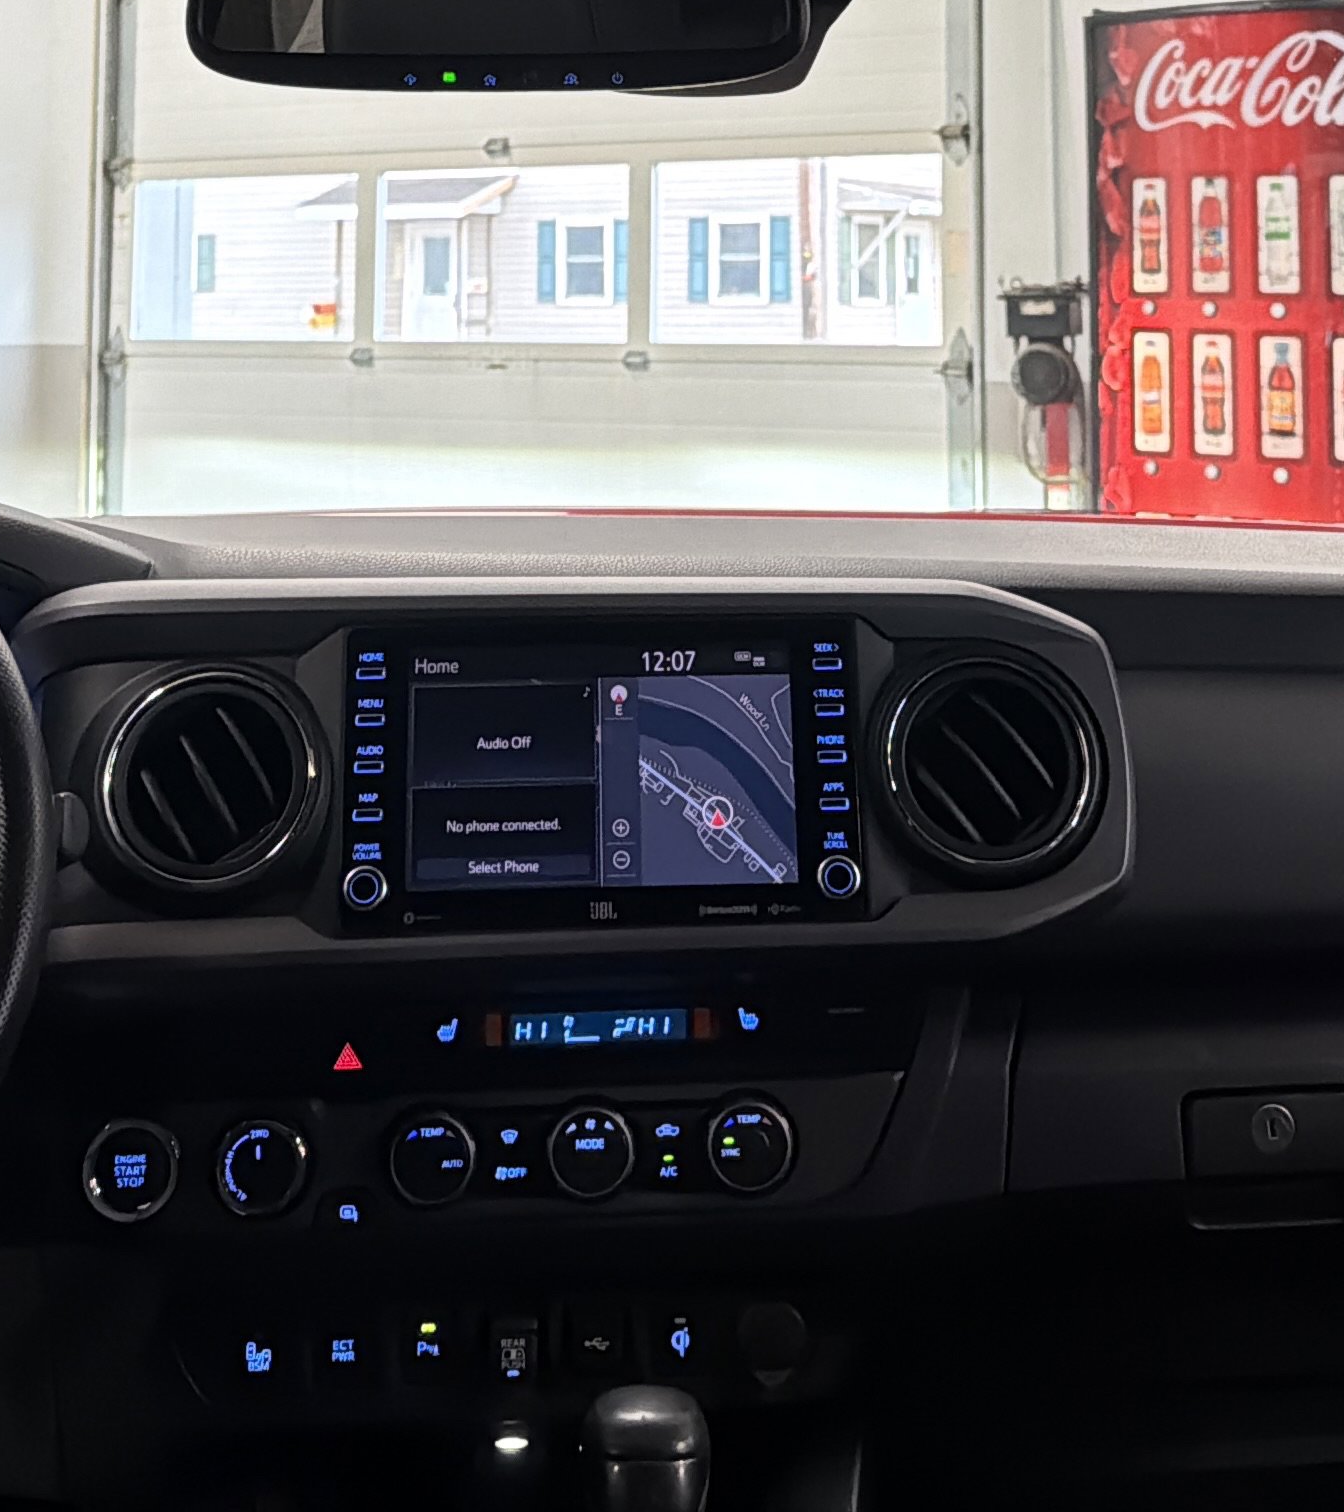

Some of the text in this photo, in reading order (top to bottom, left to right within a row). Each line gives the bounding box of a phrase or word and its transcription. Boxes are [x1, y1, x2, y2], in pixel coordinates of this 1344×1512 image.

[359, 652, 384, 662] HOME
[642, 651, 696, 672] 12:07
[415, 658, 459, 674] Home
[358, 699, 384, 708] MENU
[615, 704, 623, 716] E
[739, 693, 770, 731] Wood Ln
[477, 736, 531, 750] Audio Off
[817, 735, 845, 744] PHONE
[356, 745, 384, 755] AUDIO
[823, 782, 844, 792] APPS
[358, 793, 378, 802] MAP
[446, 818, 562, 834] No phone connected.
[468, 860, 539, 874] Select Phone
[736, 1114, 761, 1124] TEMP
[420, 1127, 444, 1137] TEMP
[576, 1138, 605, 1150] MODE
[721, 1148, 740, 1158] SYNC
[114, 1154, 146, 1164] ENGINE
[114, 1165, 146, 1177] START
[508, 1167, 527, 1178] OFF
[659, 1166, 678, 1178] A/C
[117, 1177, 144, 1188] STOP
[333, 1340, 354, 1351] ECT
[501, 1338, 526, 1347] REAR
[332, 1351, 355, 1362] PWR
